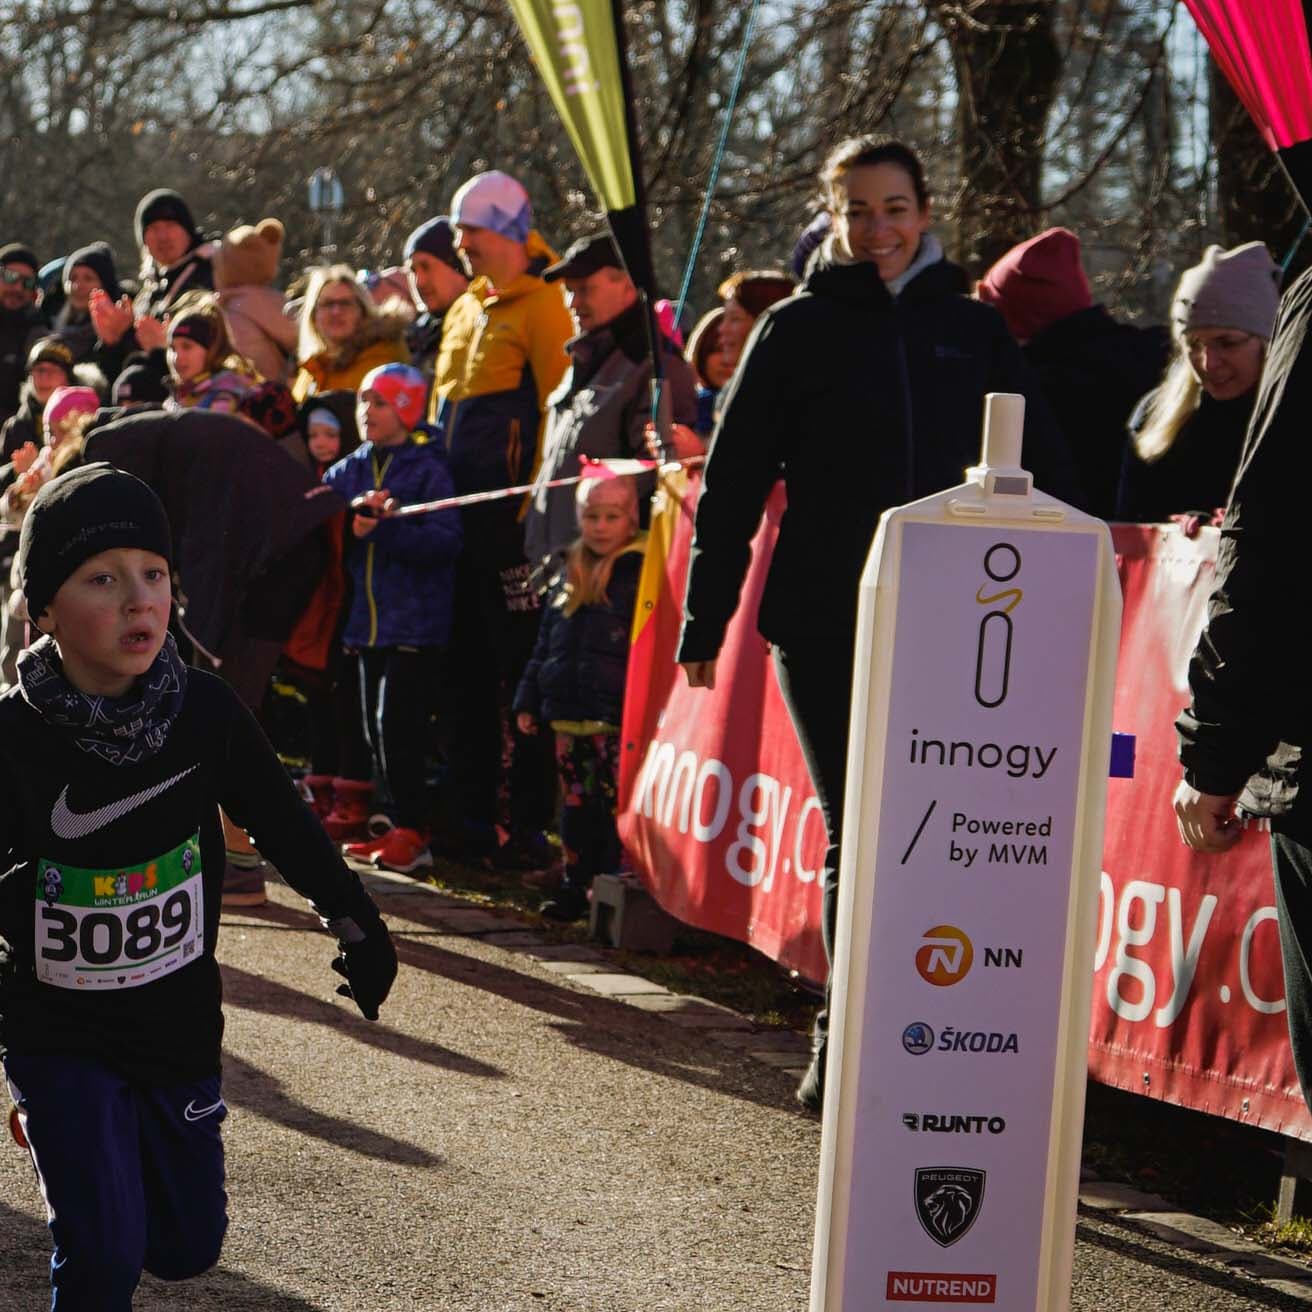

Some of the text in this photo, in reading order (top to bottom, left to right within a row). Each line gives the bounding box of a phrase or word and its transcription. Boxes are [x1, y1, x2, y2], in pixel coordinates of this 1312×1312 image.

[908, 728, 1058, 779] innogy
[634, 708, 826, 893] innogy.c
[952, 812, 1053, 838] Powered
[948, 839, 1048, 868] by MVM
[94, 894, 135, 906] WINTER
[40, 889, 192, 965] 3089
[984, 947, 1024, 969] NN
[937, 1026, 1020, 1055] ŠKODA
[921, 1113, 1006, 1135] RUNTO
[921, 1172, 980, 1184] PEUGEOT
[892, 1277, 991, 1298] NUTREND
